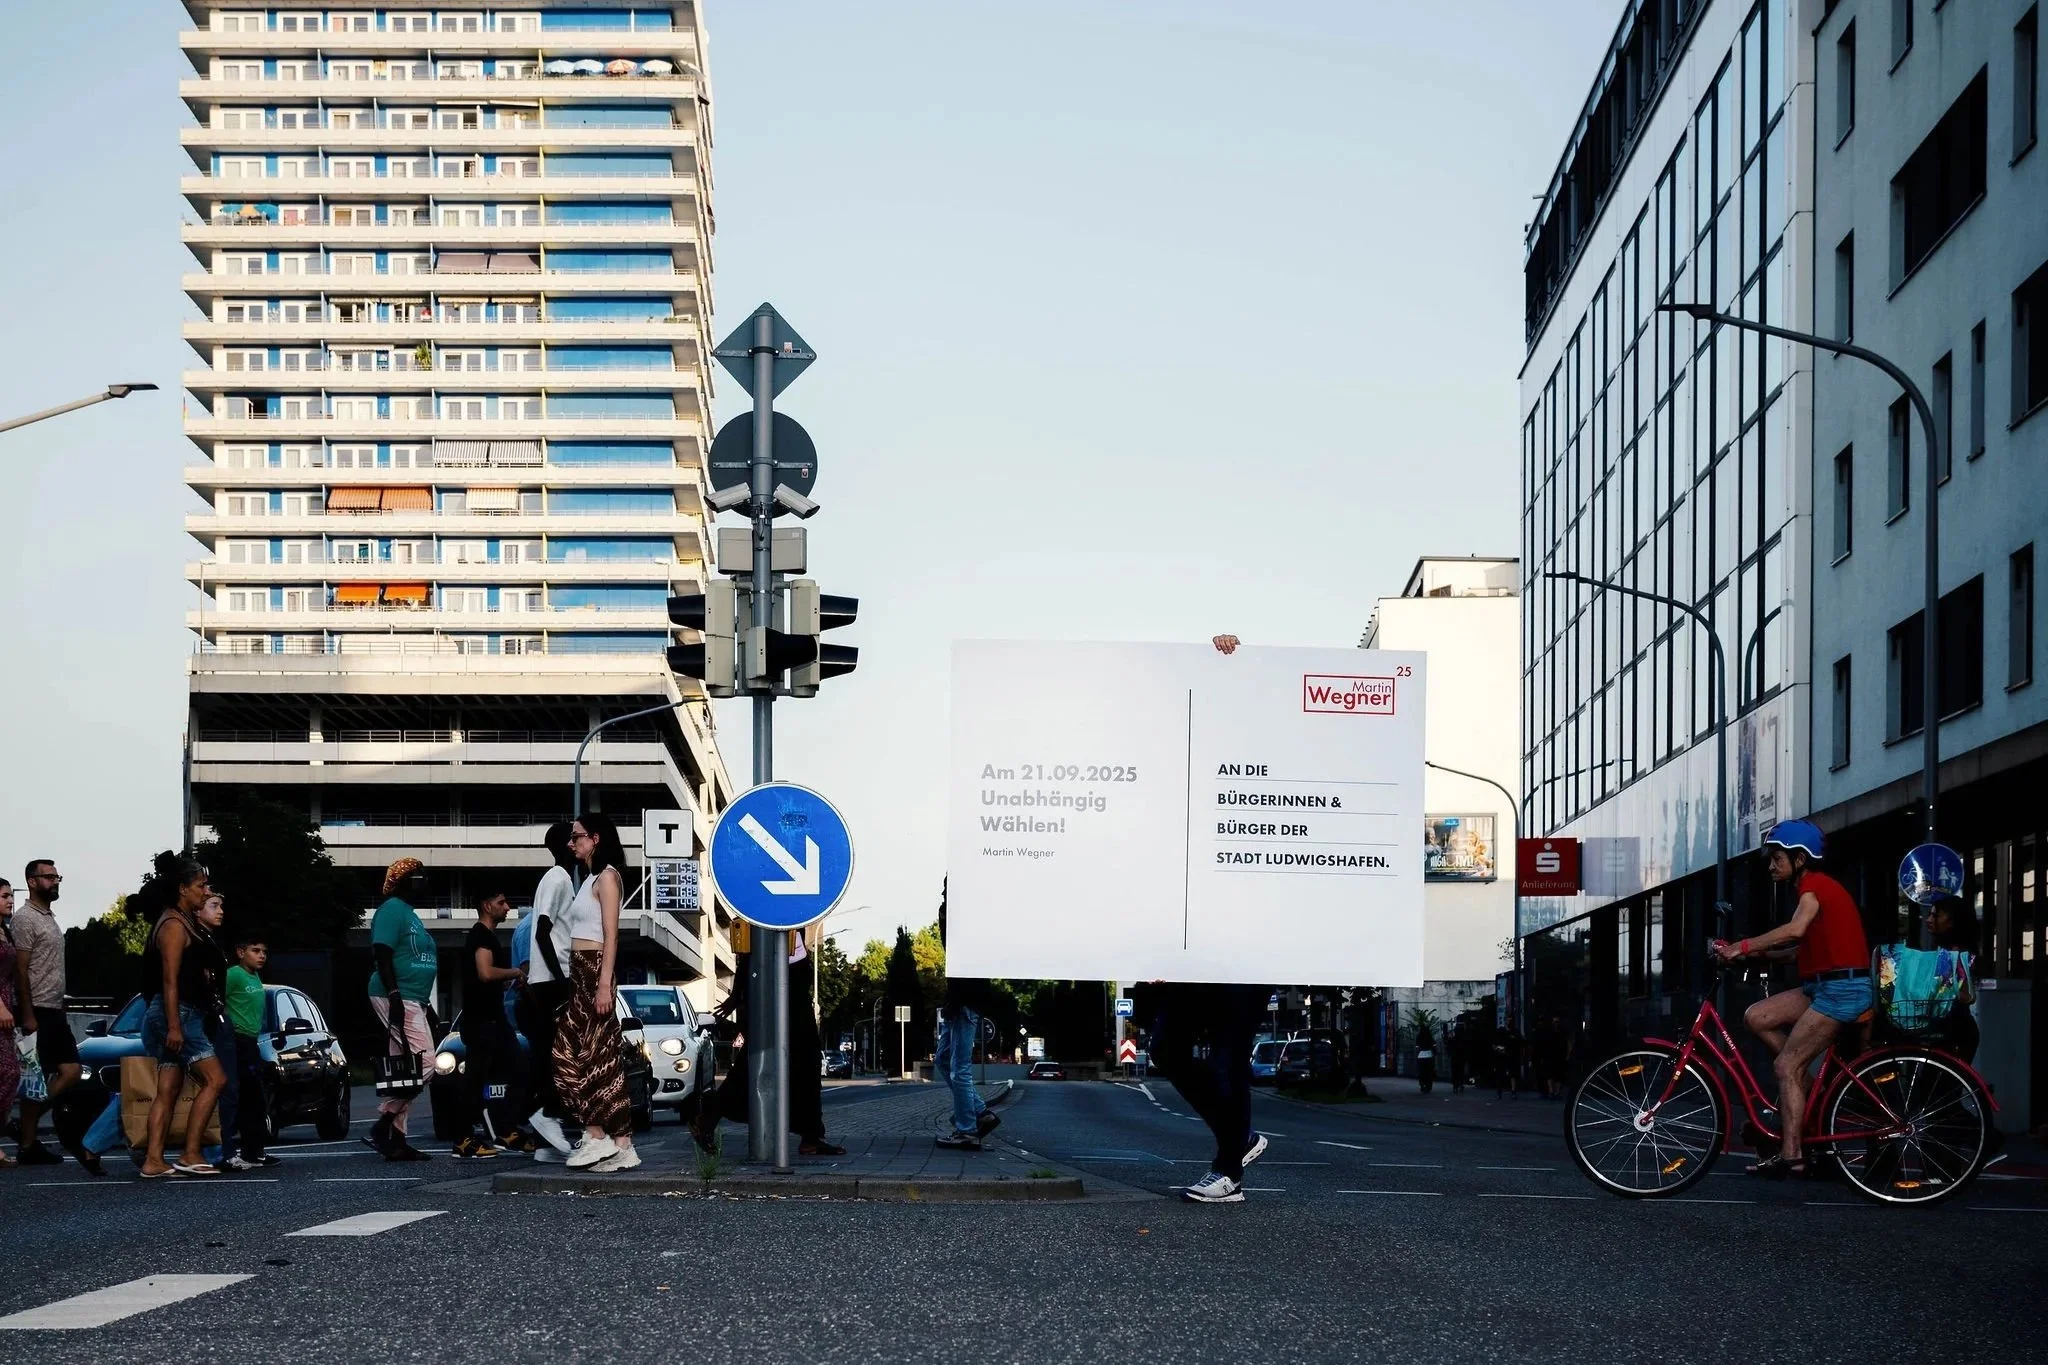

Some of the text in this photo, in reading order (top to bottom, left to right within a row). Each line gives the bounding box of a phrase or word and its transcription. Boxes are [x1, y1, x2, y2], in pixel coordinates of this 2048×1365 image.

[1396, 665, 1412, 677] 25
[1352, 681, 1392, 693] Martin
[1308, 686, 1391, 710] Wegner
[981, 764, 1138, 783] Am 21.09.2025
[1217, 764, 1268, 777] AN DIE
[981, 789, 1107, 813] Unabhängig
[1217, 791, 1342, 808] BÜRGERINNEN &
[980, 815, 1066, 834] Wählen!
[1217, 820, 1308, 836] BÜRGER DER
[659, 824, 679, 844] T
[982, 846, 1056, 859] Martin Wegner
[1216, 852, 1390, 868] STADT LUDWIGSHAFEN.
